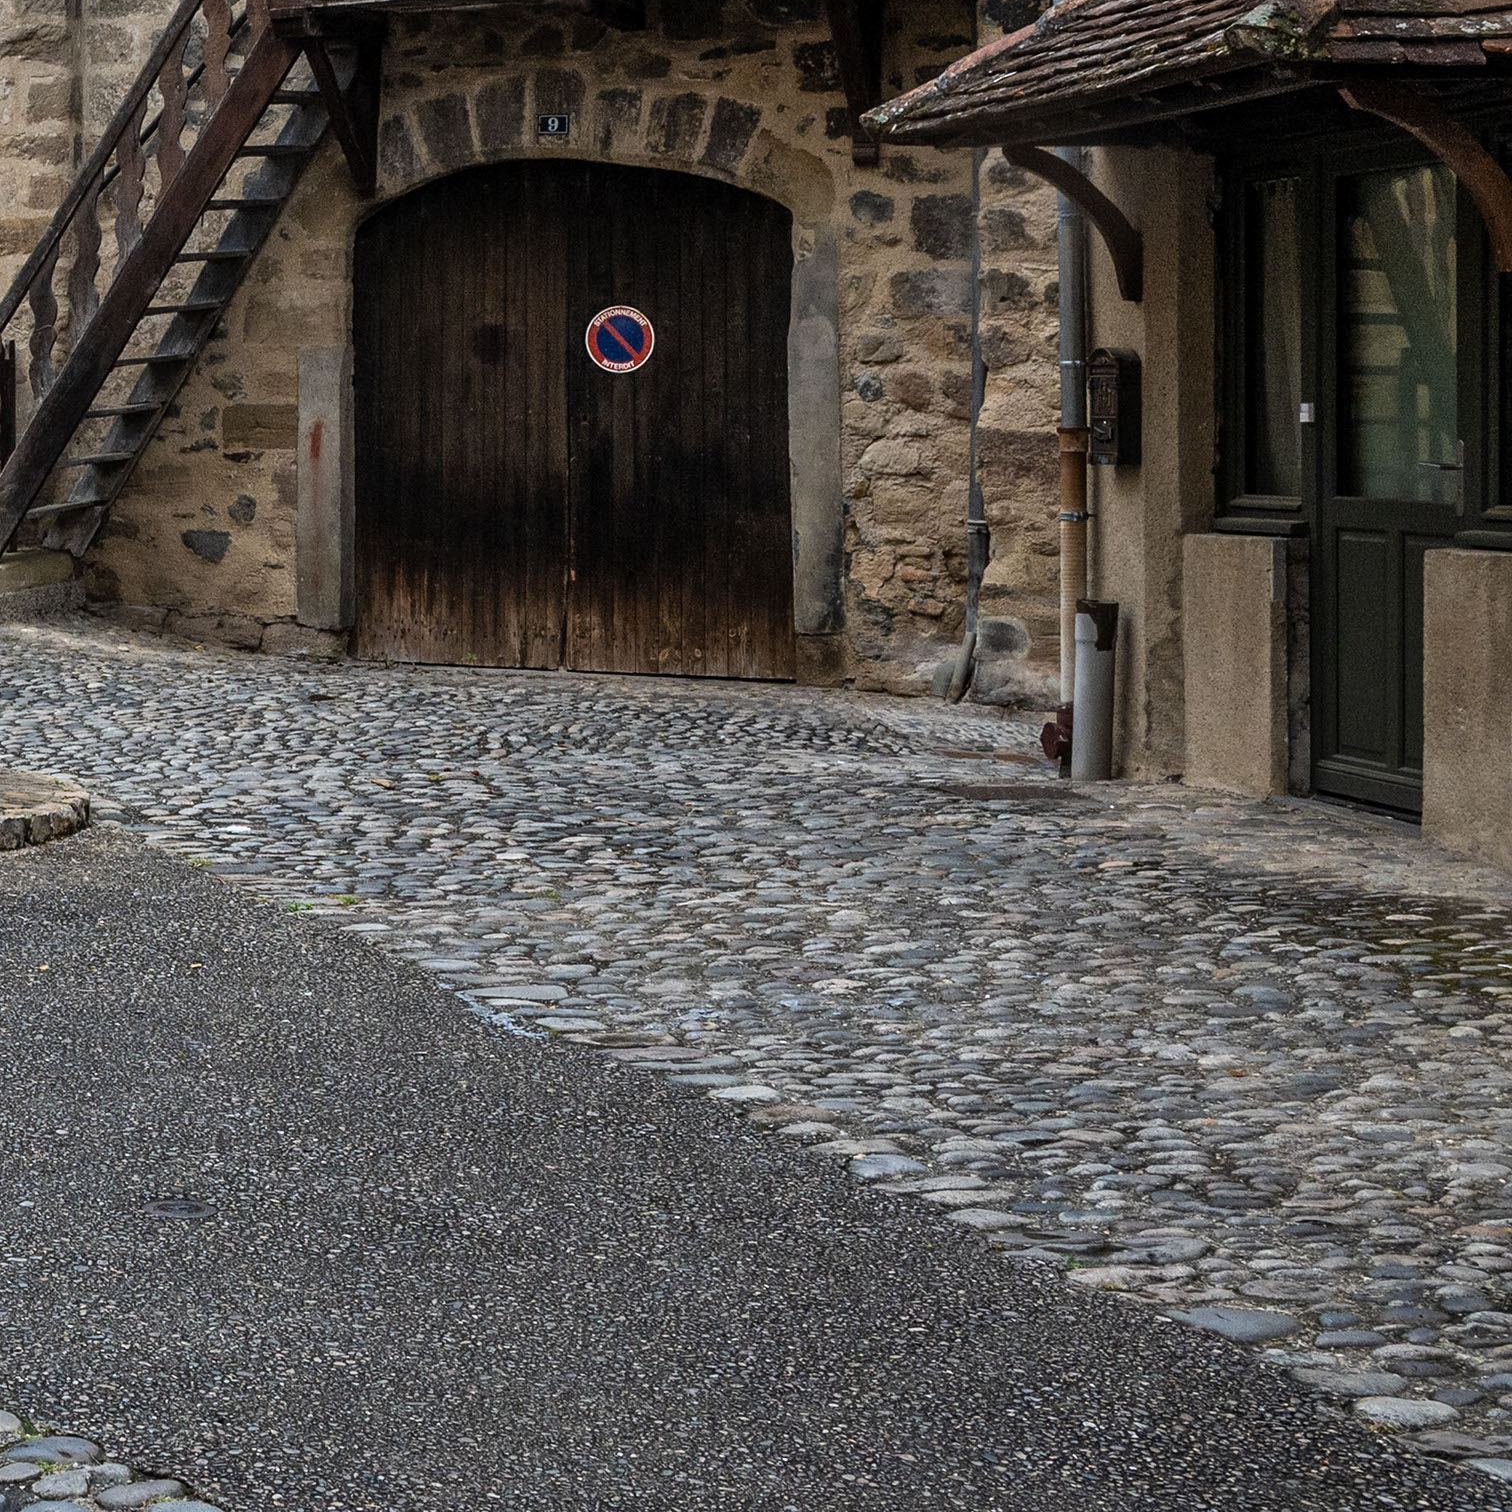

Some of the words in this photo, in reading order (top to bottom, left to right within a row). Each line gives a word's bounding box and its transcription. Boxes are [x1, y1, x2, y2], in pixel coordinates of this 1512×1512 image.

[547, 117, 559, 132] 9
[594, 309, 647, 327] STATIONNEMENT
[601, 359, 635, 370] INTERDIT
